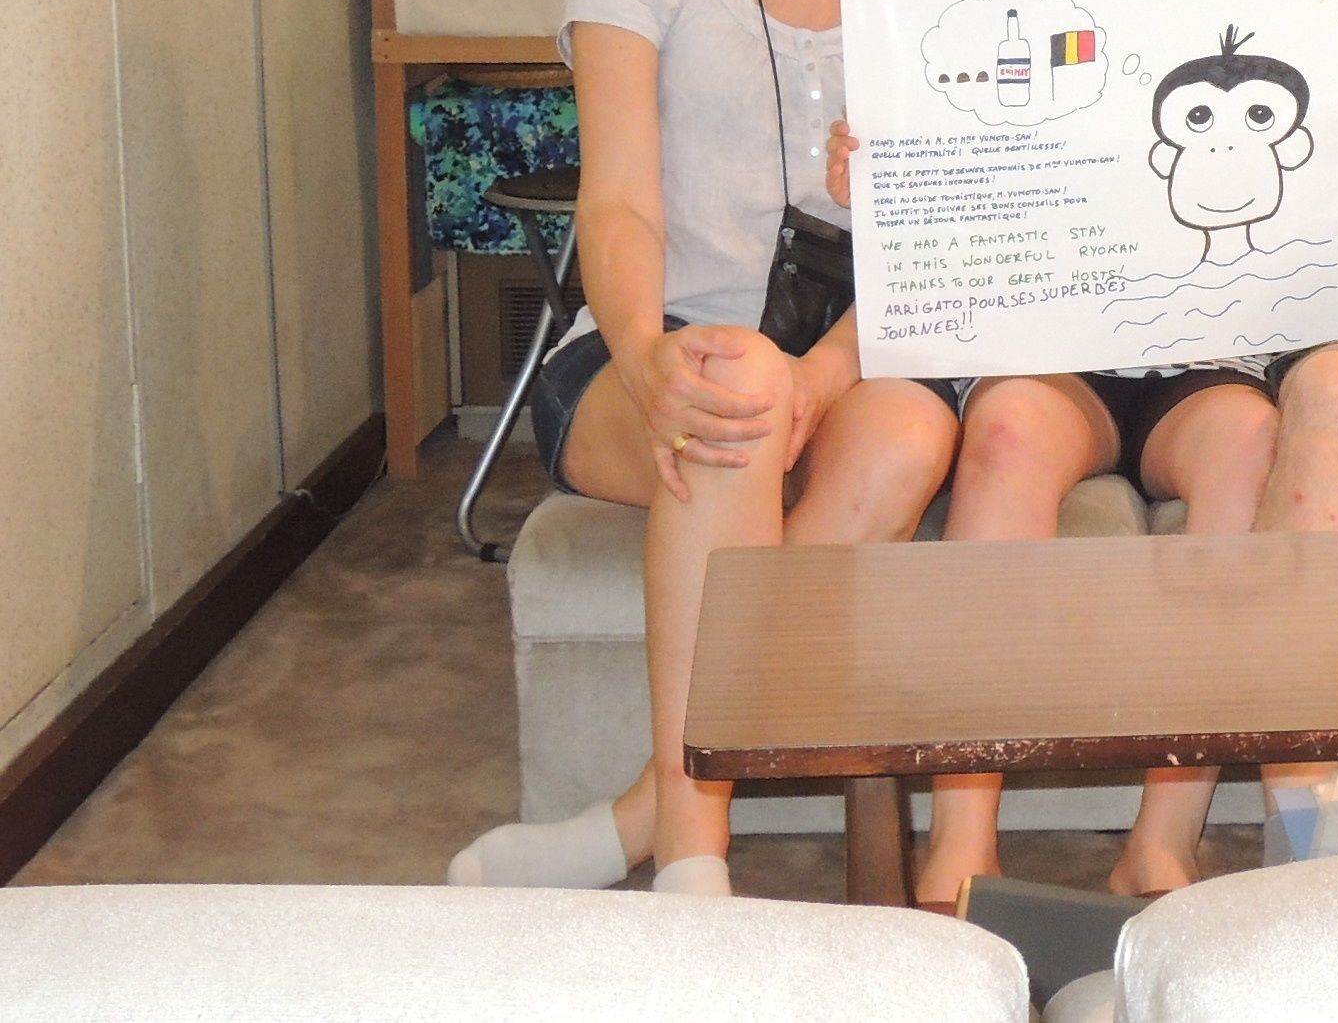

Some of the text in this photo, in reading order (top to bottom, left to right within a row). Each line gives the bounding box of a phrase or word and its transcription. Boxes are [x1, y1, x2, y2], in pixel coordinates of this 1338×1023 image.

[881, 225, 1106, 251] WE HAD A FANTASTIC STAY
[962, 250, 1055, 268] WONDERFUL
[1079, 242, 1139, 258] RYOKAN
[886, 277, 945, 294] THANKS
[968, 275, 994, 288] OUR
[1008, 272, 1054, 286] GREAT
[1039, 281, 1126, 302] SUPERBES
